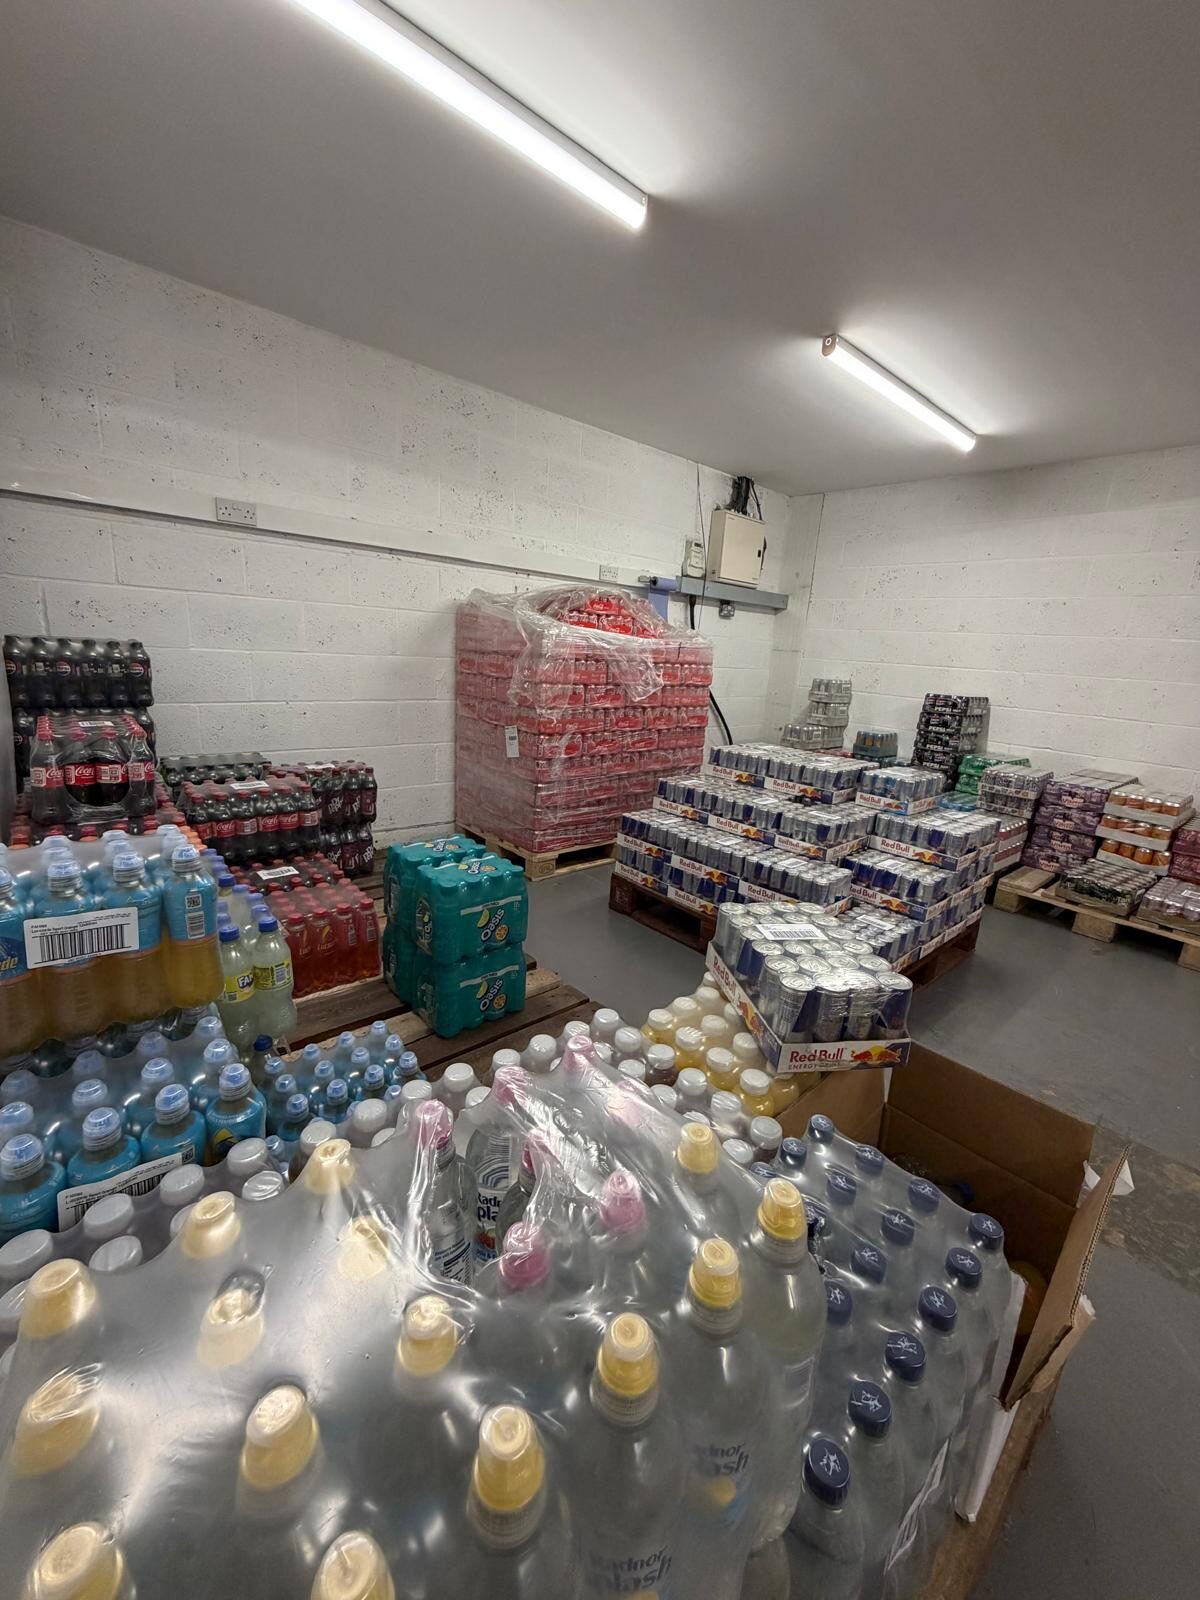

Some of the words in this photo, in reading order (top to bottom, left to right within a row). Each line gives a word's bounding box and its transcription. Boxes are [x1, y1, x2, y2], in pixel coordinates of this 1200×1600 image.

[881, 840, 895, 849] Red
[896, 843, 910, 852] Bull
[748, 885, 761, 896] Red
[761, 890, 775, 900] Bull
[480, 908, 504, 940] Oasis
[0, 956, 18, 972] de
[480, 978, 502, 1011] Oasis
[790, 1049, 818, 1063] Red
[818, 1048, 844, 1061] Bull
